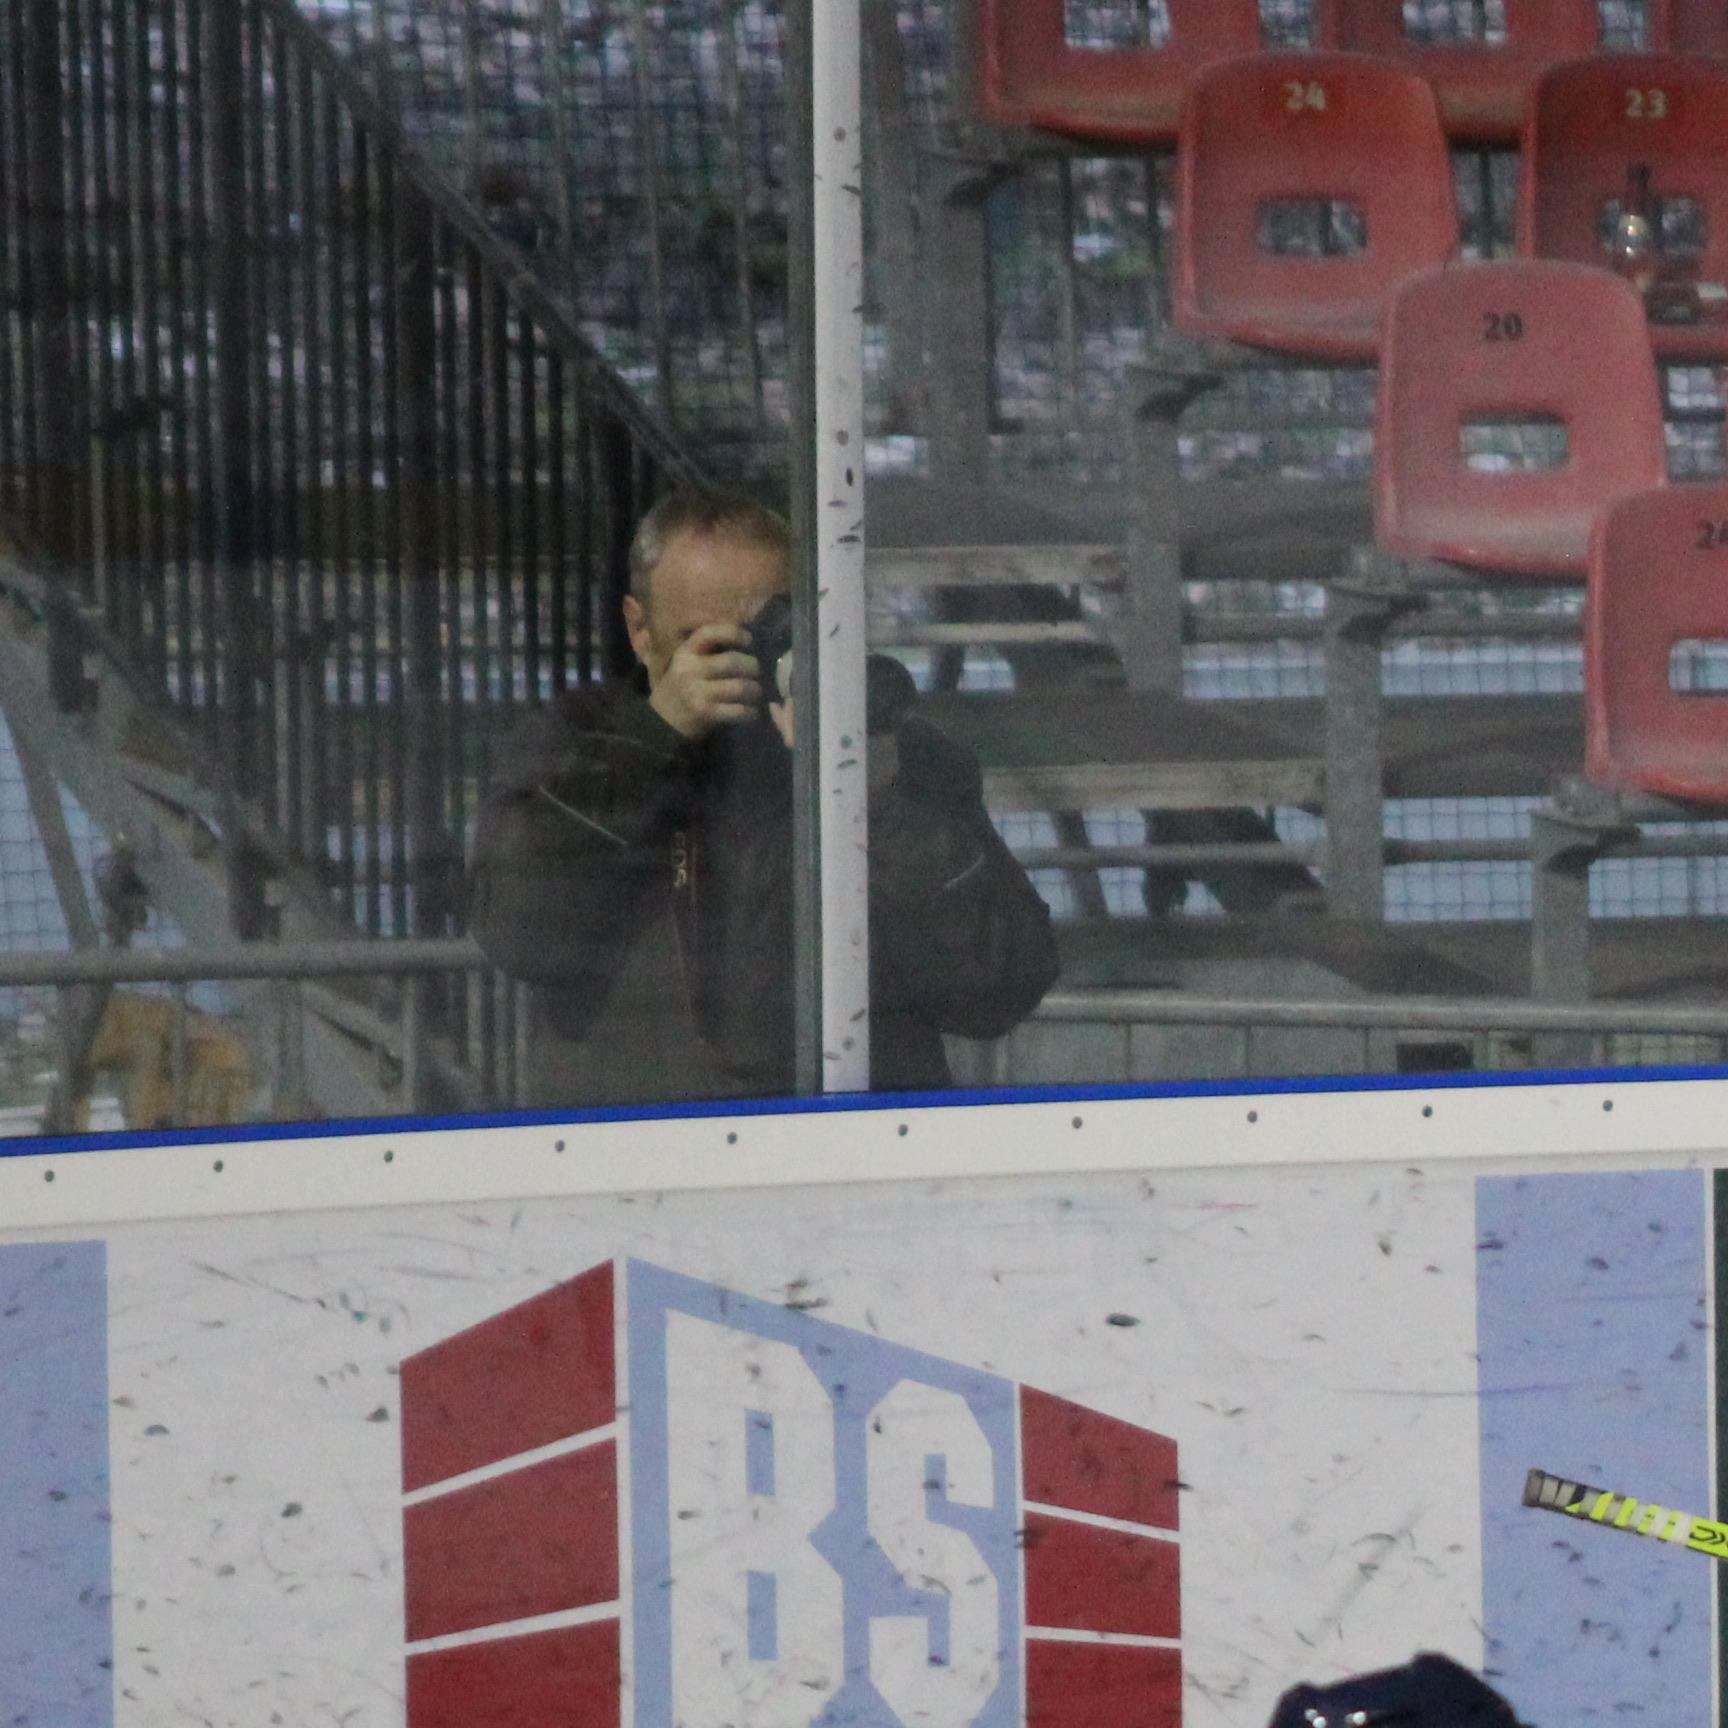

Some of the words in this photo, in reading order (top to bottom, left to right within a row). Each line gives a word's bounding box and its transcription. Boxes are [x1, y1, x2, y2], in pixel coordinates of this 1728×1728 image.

[1285, 81, 1327, 114] 24
[1624, 87, 1668, 120] 23
[1482, 312, 1524, 342] 20
